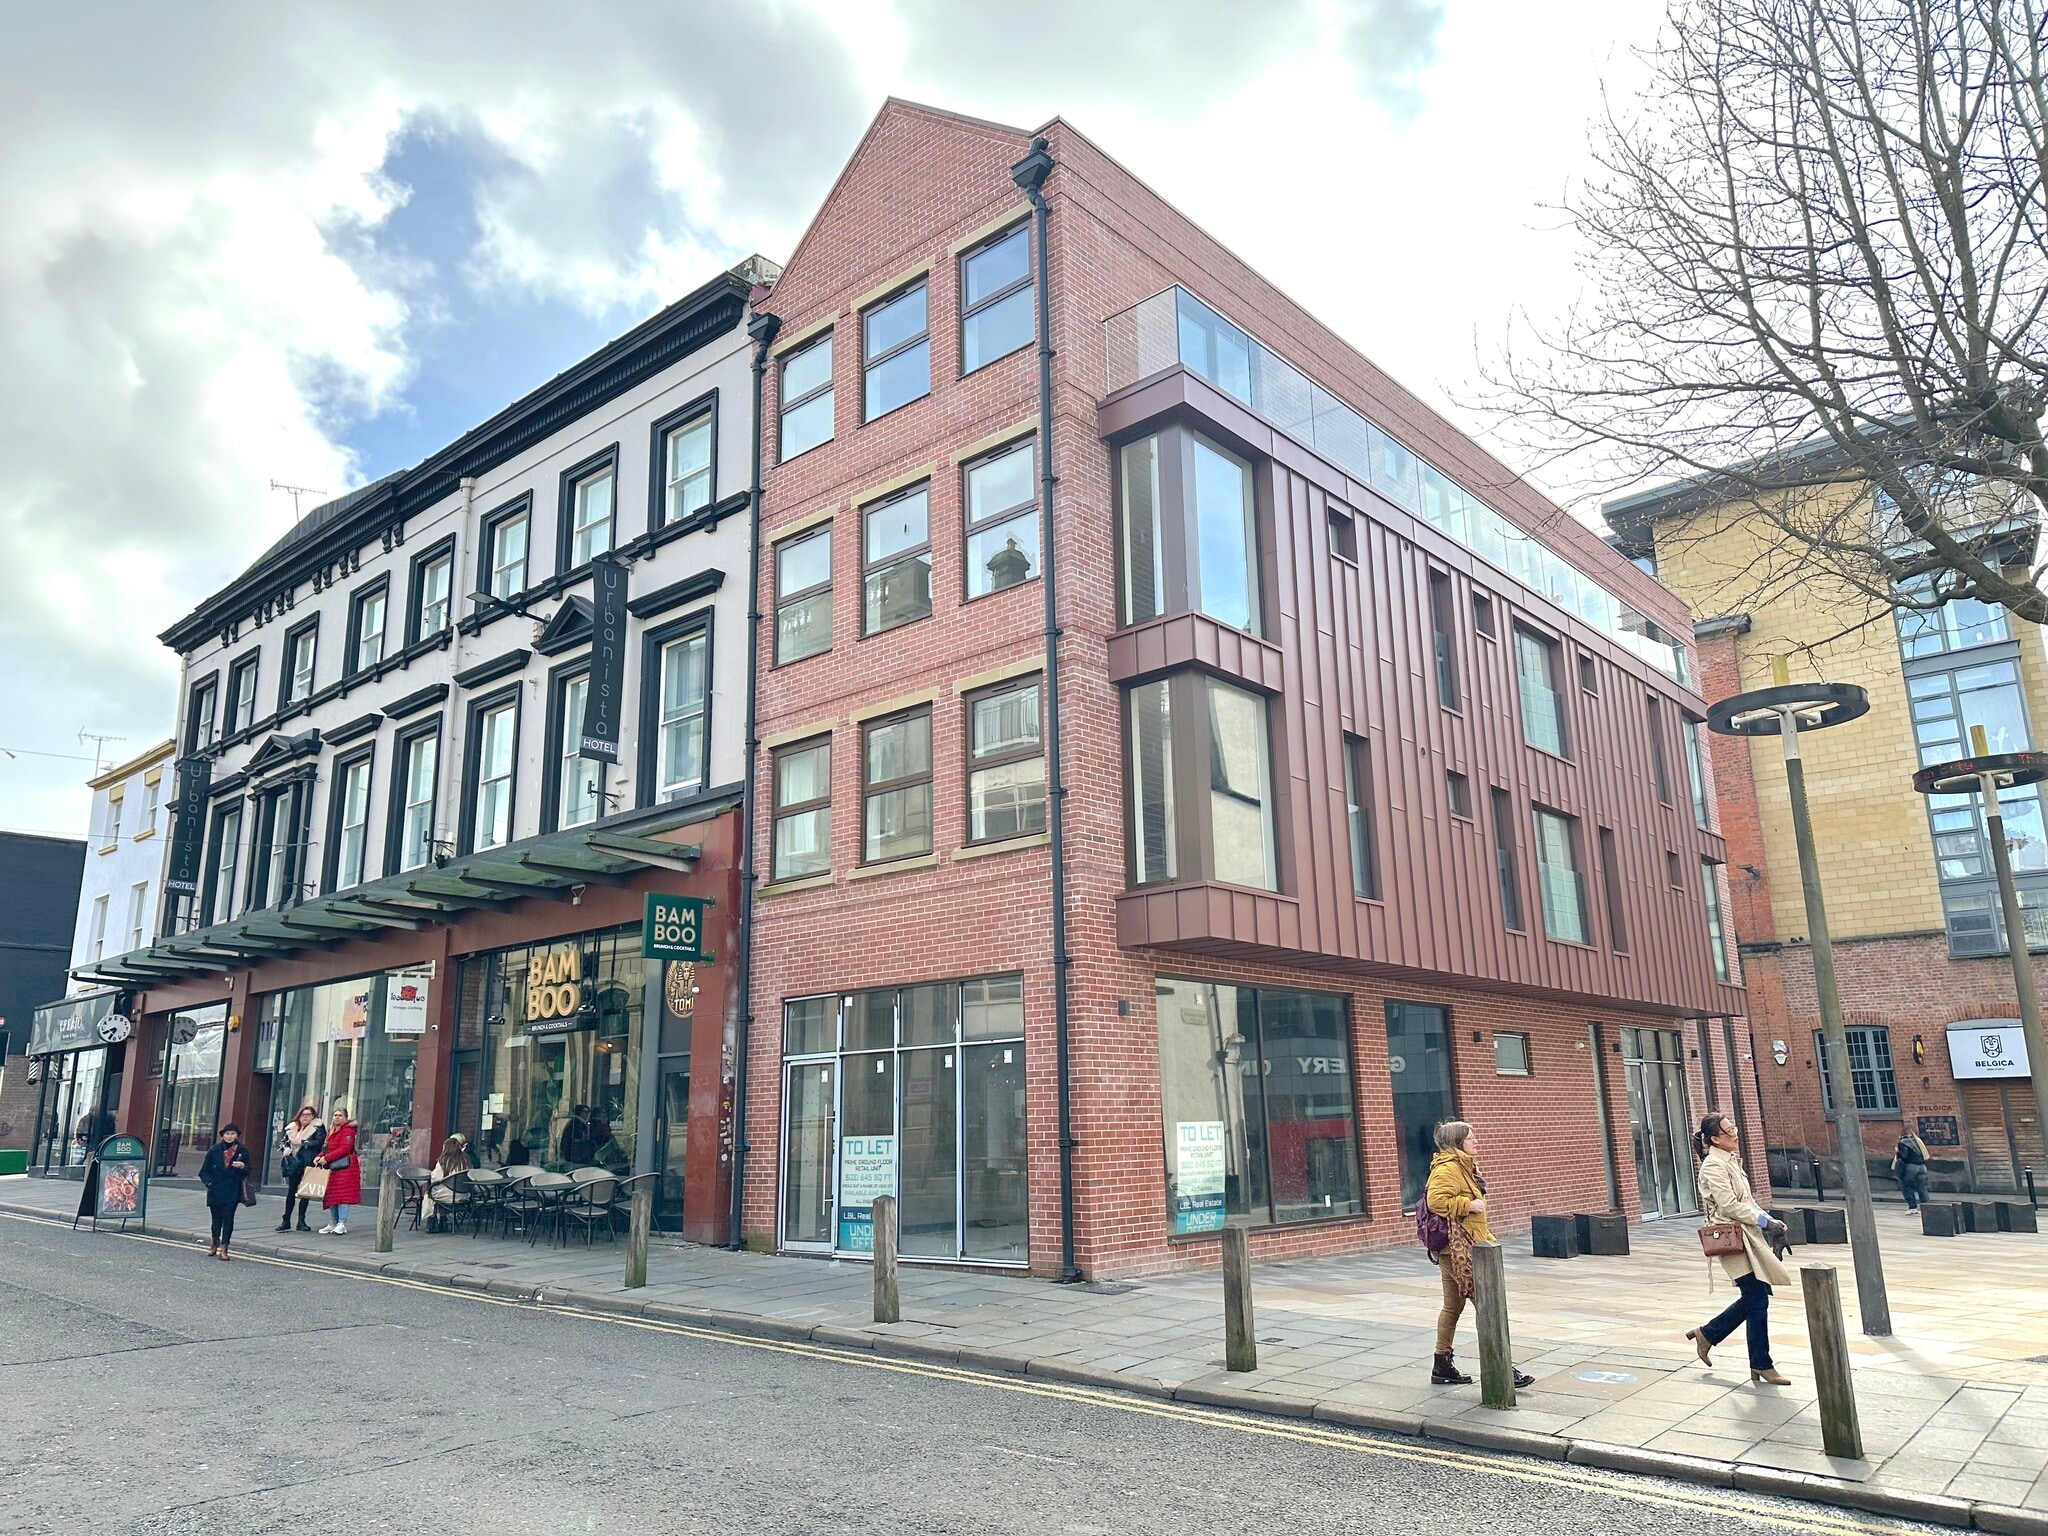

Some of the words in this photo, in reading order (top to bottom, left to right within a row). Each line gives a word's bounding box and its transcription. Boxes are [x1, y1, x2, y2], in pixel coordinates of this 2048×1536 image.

[595, 570, 617, 736] Urbanista
[583, 738, 616, 754] HOTEL
[179, 765, 202, 878] Urbanista
[167, 880, 195, 891] HOTEL
[655, 905, 695, 926] BAM
[654, 924, 696, 944] BOO
[530, 949, 579, 987] BAM
[527, 983, 580, 1021] BOO
[1180, 1126, 1196, 1142] TO
[1200, 1125, 1221, 1141] LET
[846, 1140, 863, 1155] TO
[867, 1139, 893, 1155] LET
[873, 1174, 883, 1182] SQ
[1192, 1199, 1204, 1208] Real
[1205, 1199, 1222, 1207] Estate
[843, 1212, 857, 1220] LBL
[857, 1212, 871, 1220] Real
[1186, 1211, 1216, 1226] UNDER
[849, 1225, 874, 1237] UND
[851, 1237, 874, 1248] OFF
